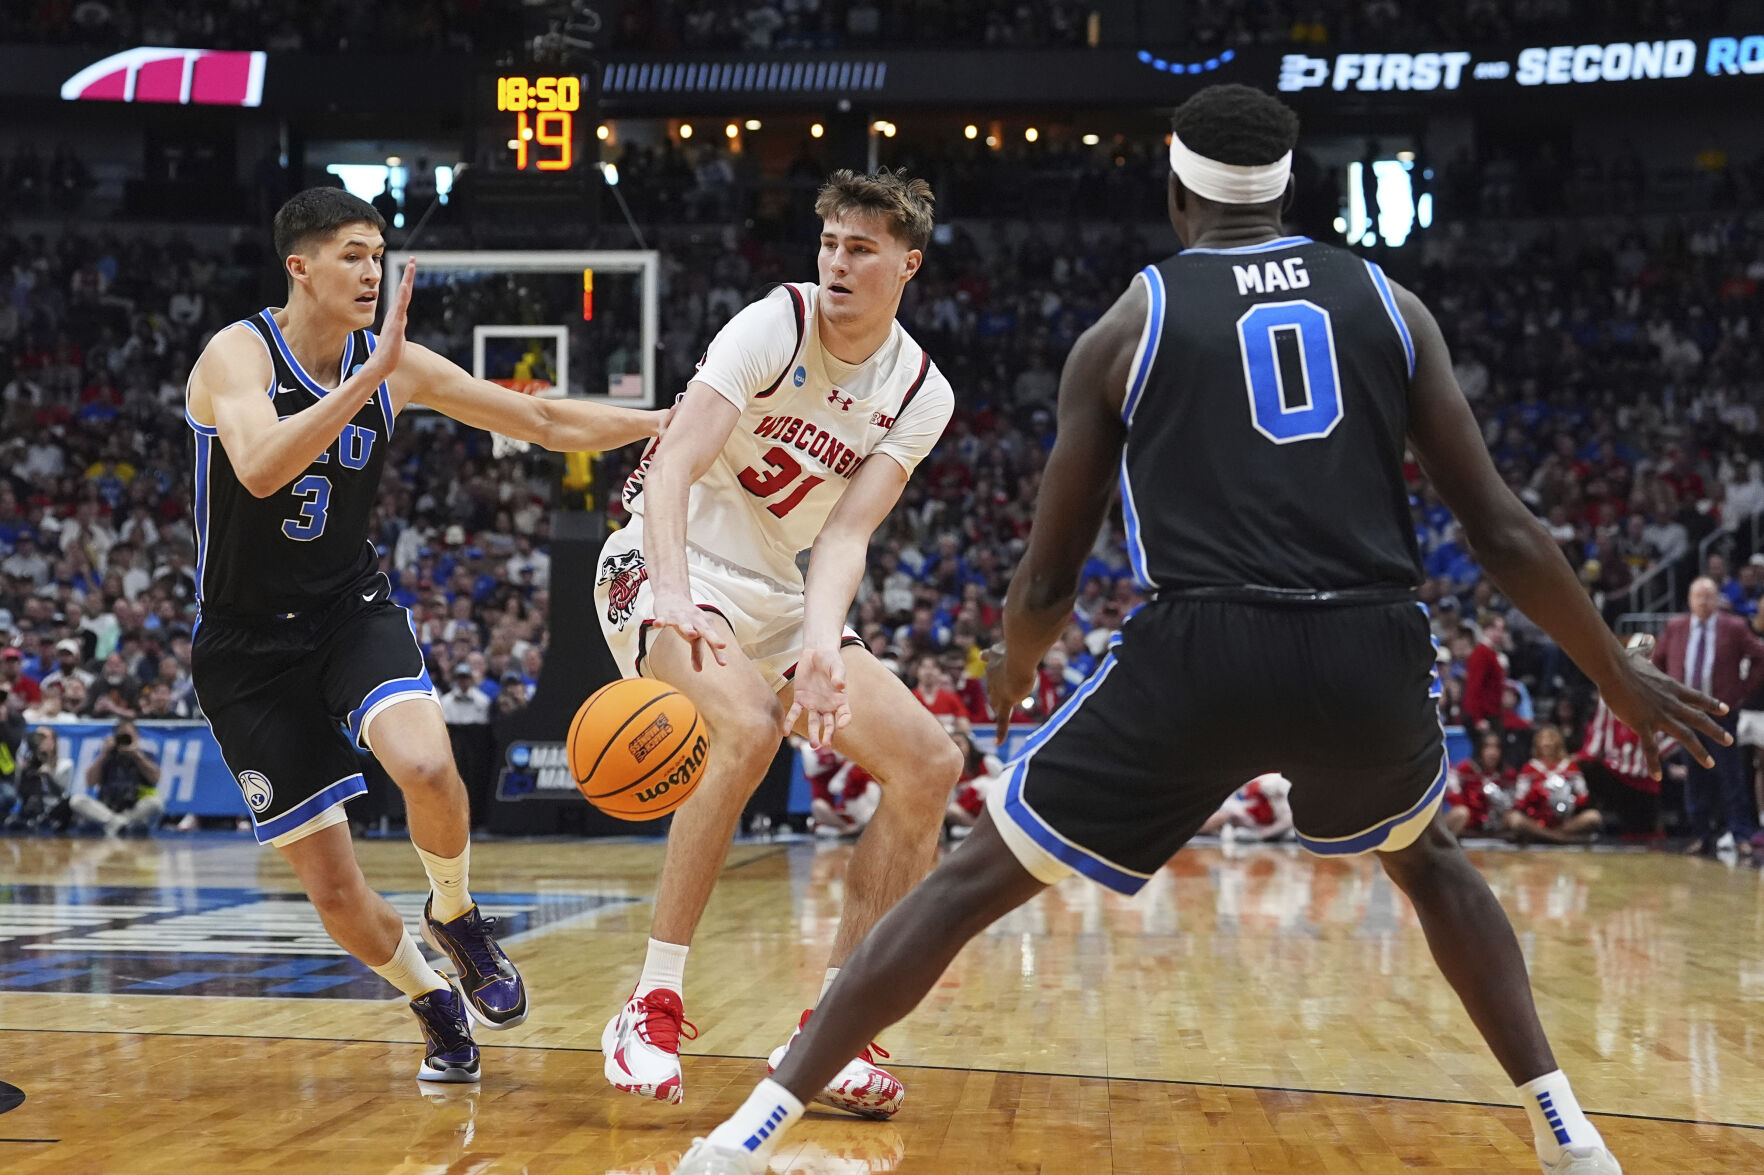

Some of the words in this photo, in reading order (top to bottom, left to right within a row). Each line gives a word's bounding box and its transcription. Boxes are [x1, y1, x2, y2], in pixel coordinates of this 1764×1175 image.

[497, 76, 580, 112] 18:50
[1332, 51, 1471, 91] FIRST
[1515, 39, 1696, 86] SECOND
[517, 111, 572, 171] 19
[1232, 257, 1310, 296] MAG
[1236, 299, 1344, 445] 0
[753, 415, 863, 480] WISCONSI
[281, 475, 333, 541] 3
[737, 446, 826, 519] 31
